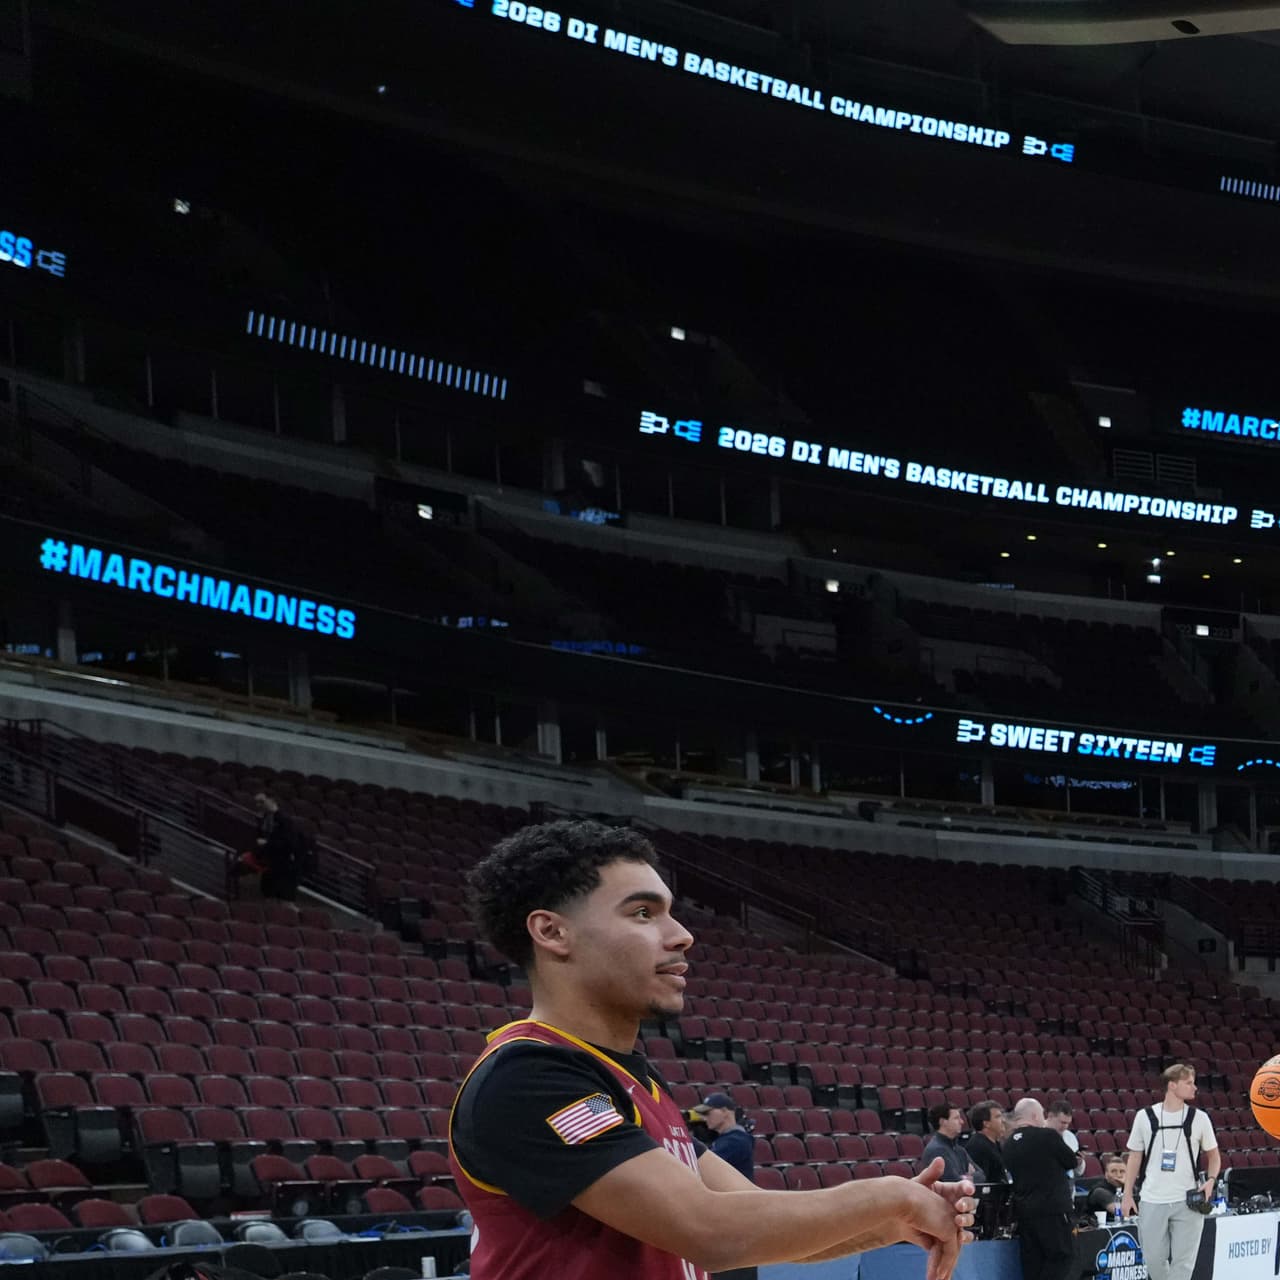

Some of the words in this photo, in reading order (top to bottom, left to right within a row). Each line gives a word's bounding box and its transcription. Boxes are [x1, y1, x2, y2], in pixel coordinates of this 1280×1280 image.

[492, 0, 560, 32] 2026
[567, 18, 598, 43] DI
[604, 29, 678, 66] MEN'S
[684, 53, 825, 110] BASKETBALL
[830, 96, 1010, 148] CHAMPIONSHIP
[718, 427, 786, 457] 2026
[792, 441, 822, 464] DI
[828, 448, 900, 478] MEN'S
[906, 462, 1049, 503] BASKETBALL
[1056, 486, 1237, 524] CHAMPIONSHIP
[40, 539, 356, 639] #MARCHMADNESS
[990, 723, 1075, 753] SWEET
[1077, 733, 1183, 763] SIXTEEN
[1107, 1249, 1135, 1268] MARCH
[1228, 1241, 1259, 1259] HOSTED
[1261, 1237, 1272, 1256] BY
